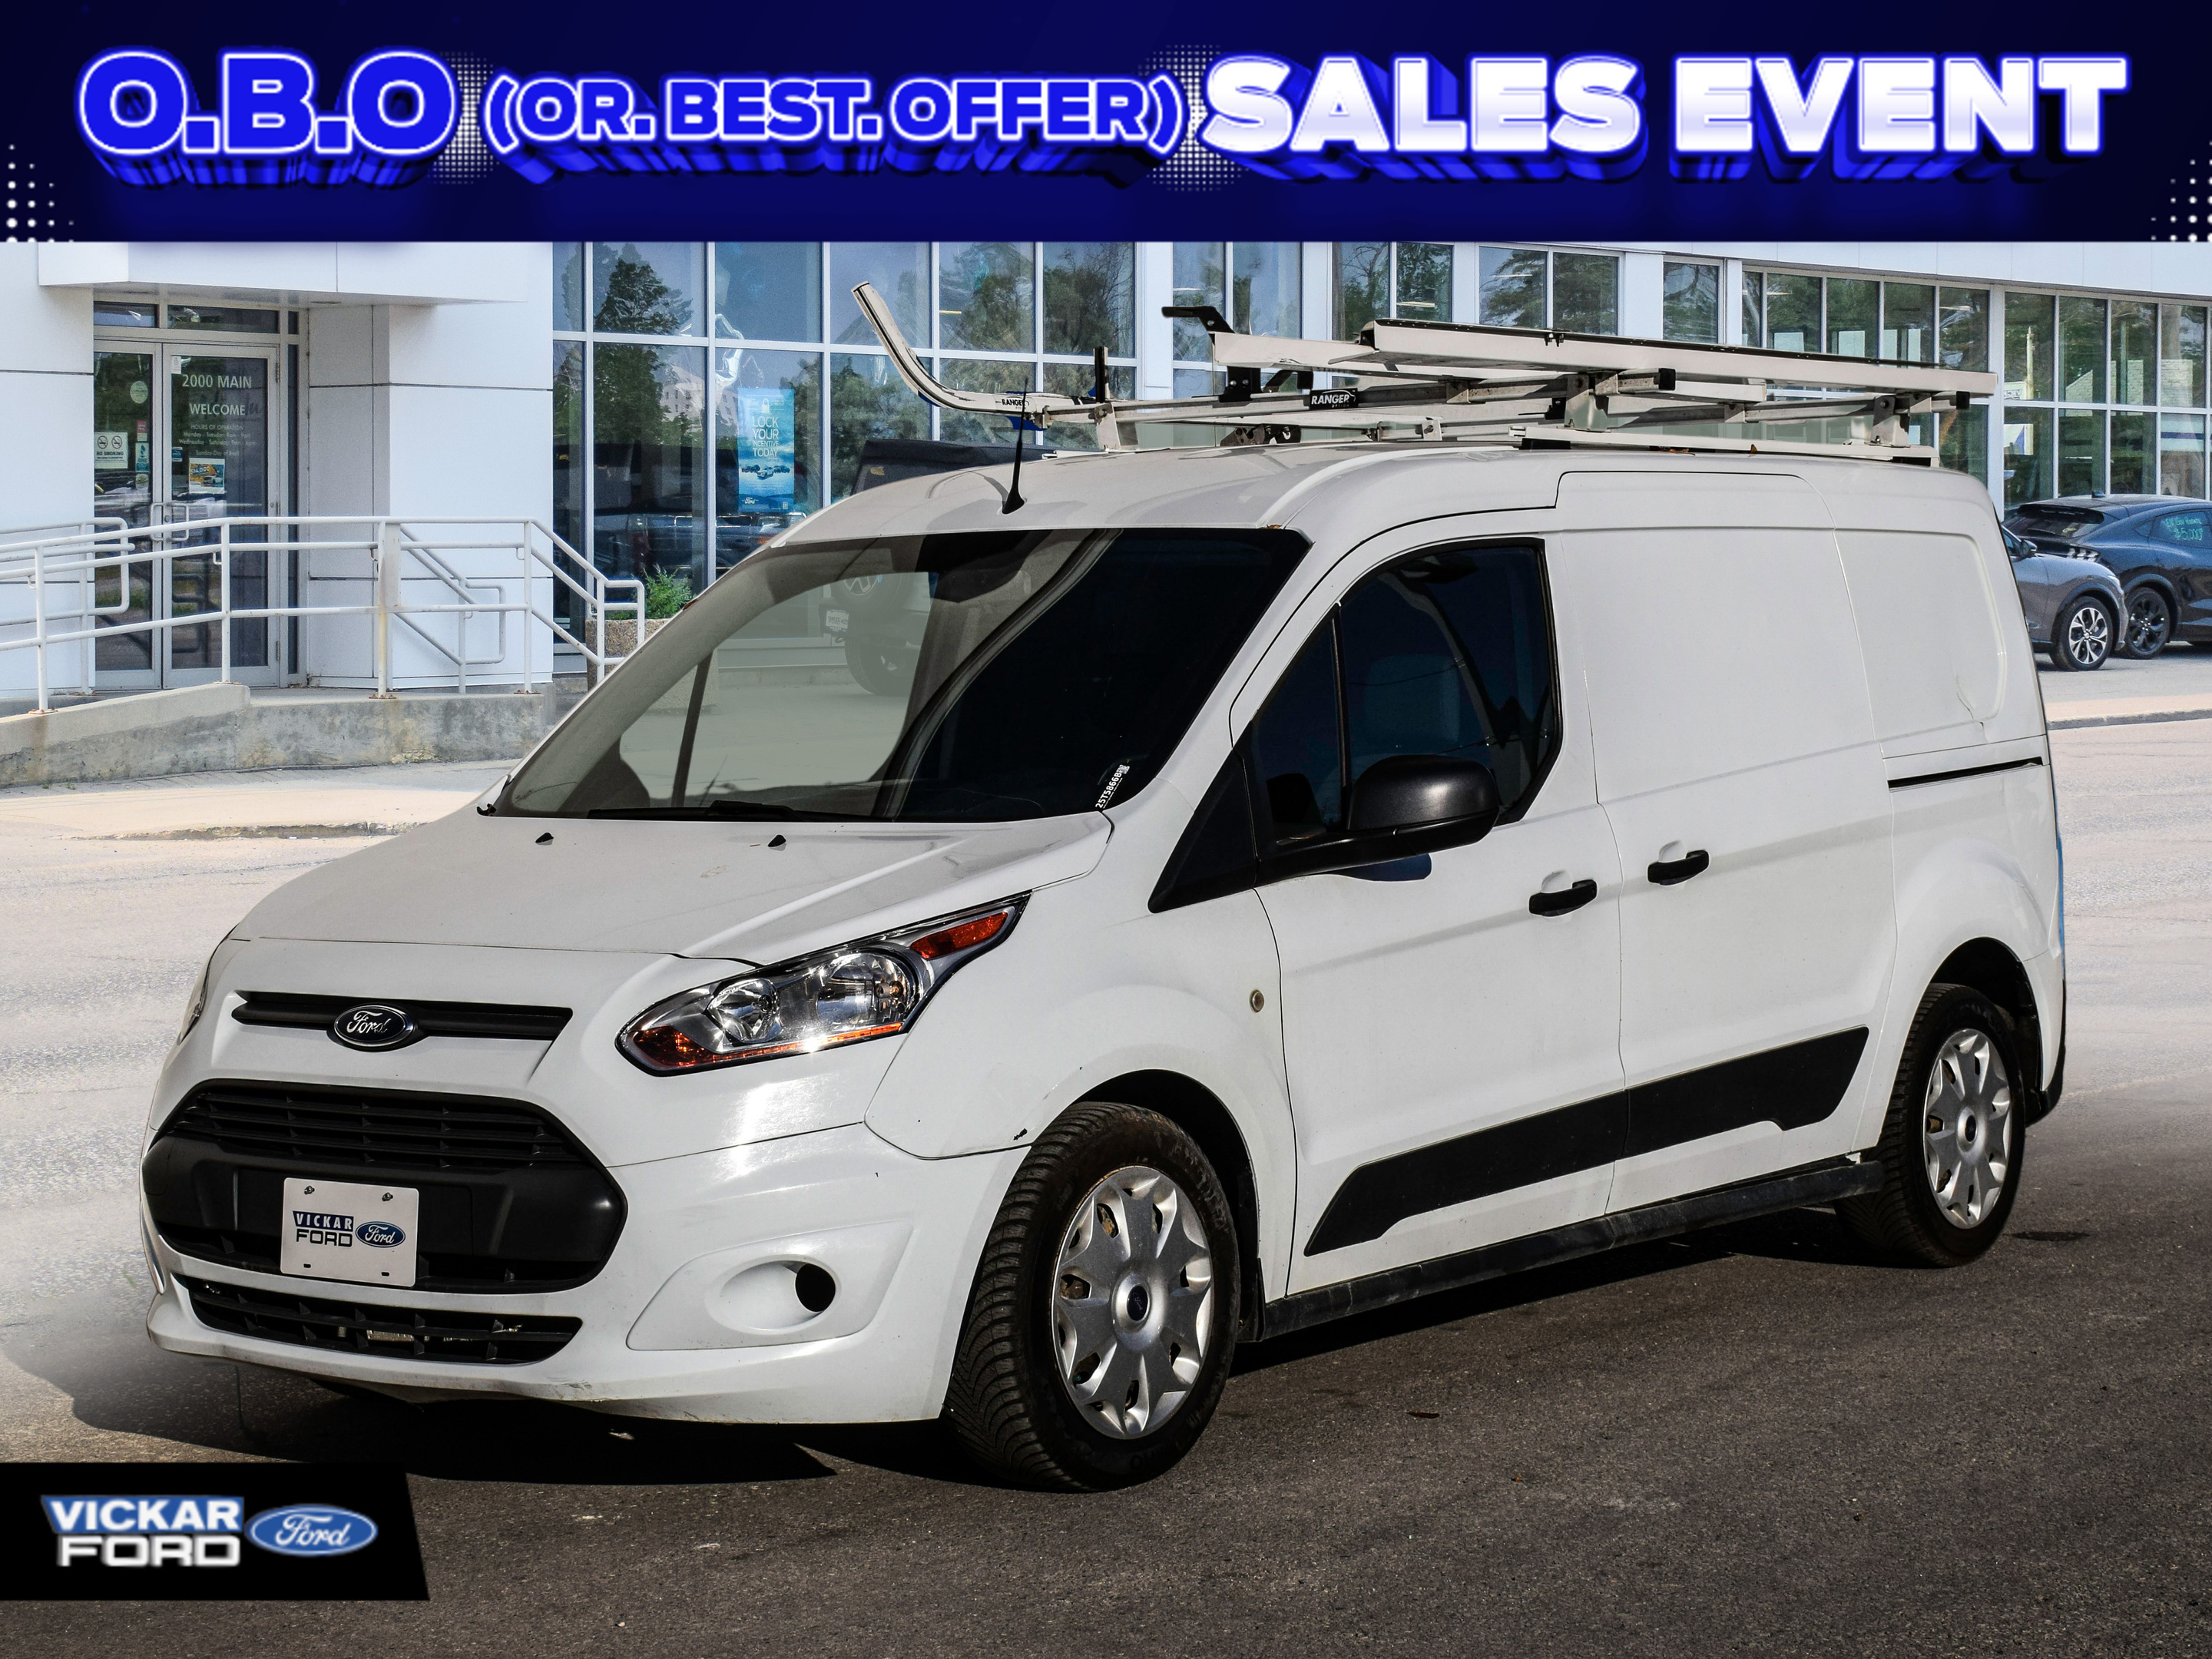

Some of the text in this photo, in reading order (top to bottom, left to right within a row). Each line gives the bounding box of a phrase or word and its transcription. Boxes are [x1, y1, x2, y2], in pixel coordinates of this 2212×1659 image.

[182, 374, 252, 389] 2000 MAIN
[1311, 394, 1349, 405] RANGER
[189, 403, 246, 416] WELCOME
[753, 416, 778, 428] LOCK
[753, 429, 779, 439] YOUR
[753, 448, 778, 457] TODAY
[346, 1011, 392, 1035] Ford
[296, 1213, 353, 1230] VICKAR
[296, 1230, 353, 1247] FORD
[364, 1224, 396, 1244] Ford
